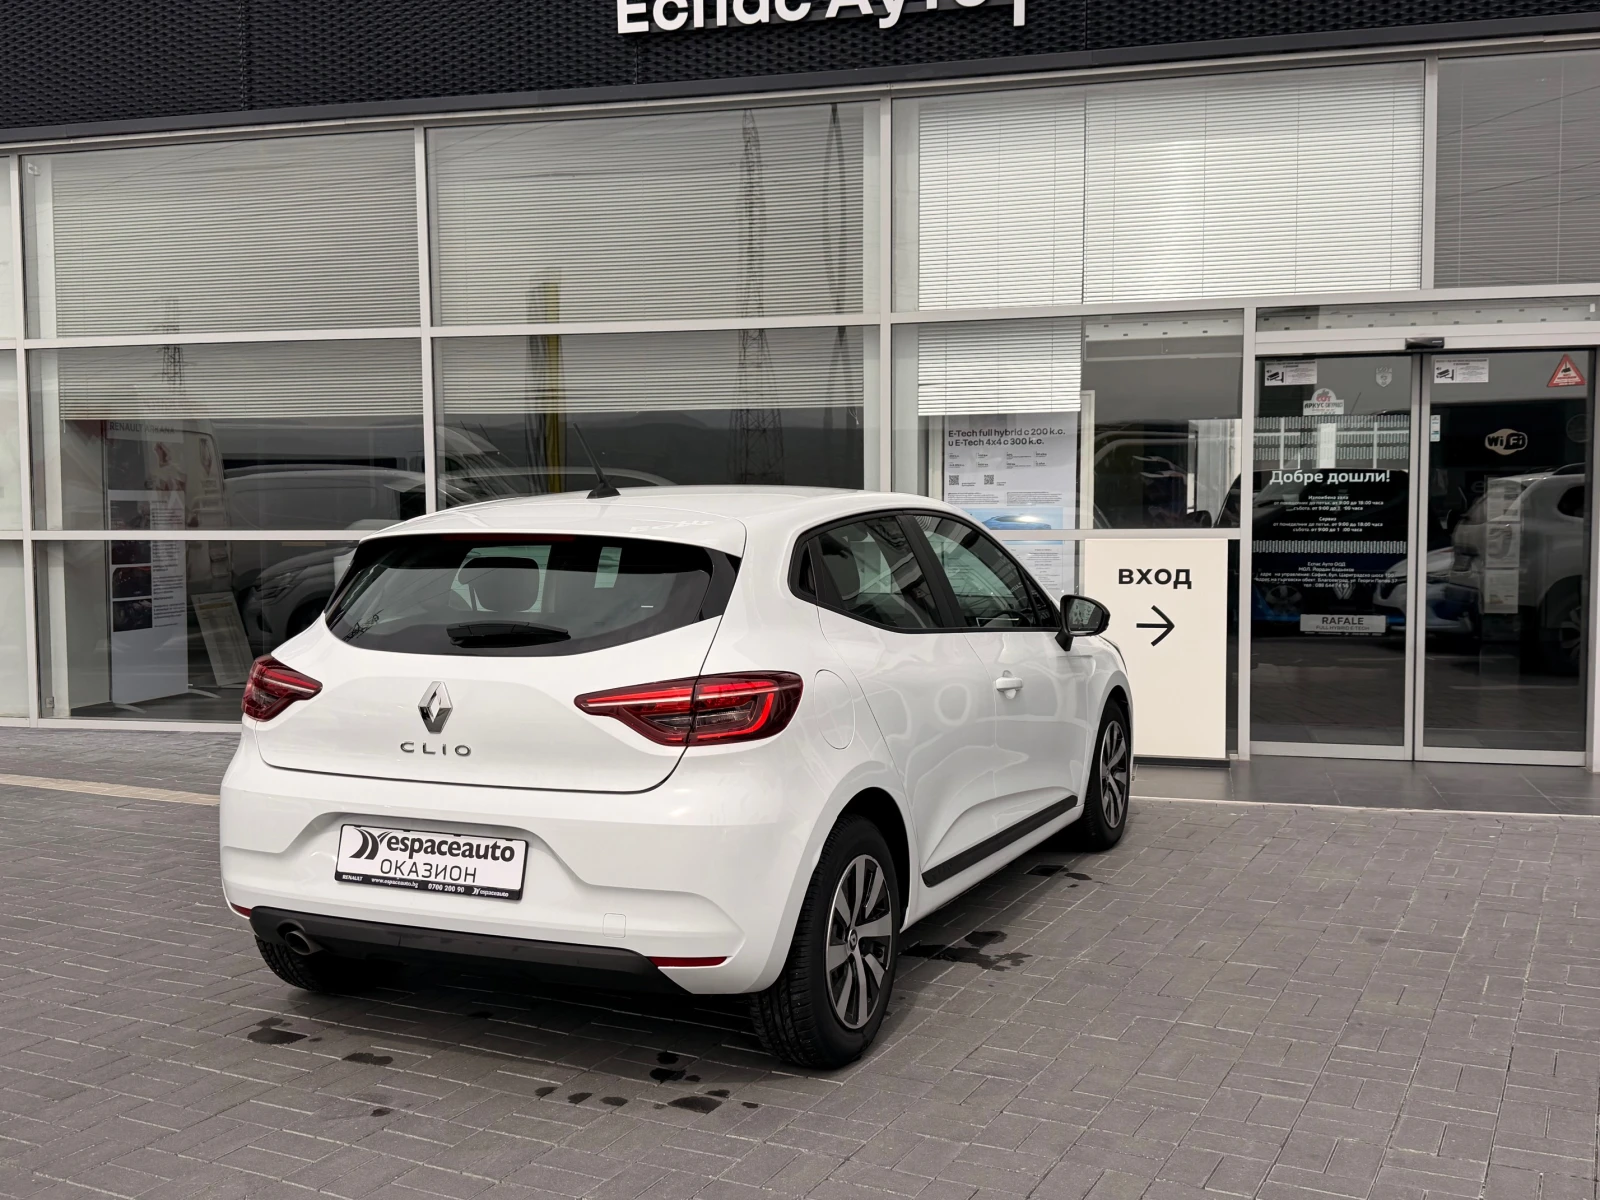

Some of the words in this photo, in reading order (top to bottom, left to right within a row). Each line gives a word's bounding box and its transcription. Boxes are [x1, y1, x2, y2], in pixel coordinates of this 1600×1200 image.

[109, 421, 143, 432] RENAULT
[948, 429, 977, 437] E-Tech
[979, 428, 993, 437] full
[994, 428, 1022, 438] hybrid
[1031, 428, 1048, 436] 200
[955, 438, 984, 446] E-Tech
[1010, 437, 1027, 445] 300
[1269, 469, 1324, 486] Добре
[1327, 469, 1391, 485] дошли!
[1118, 568, 1192, 589] ВХОД
[1322, 616, 1364, 625] RAFALE
[400, 741, 471, 757] CLIO
[387, 835, 515, 862] espaceauto
[380, 858, 477, 883] ОКАЗИОН
[342, 874, 363, 882] RENAULT
[428, 883, 443, 891] 0700
[444, 884, 456, 892] 200
[457, 885, 464, 893] 90
